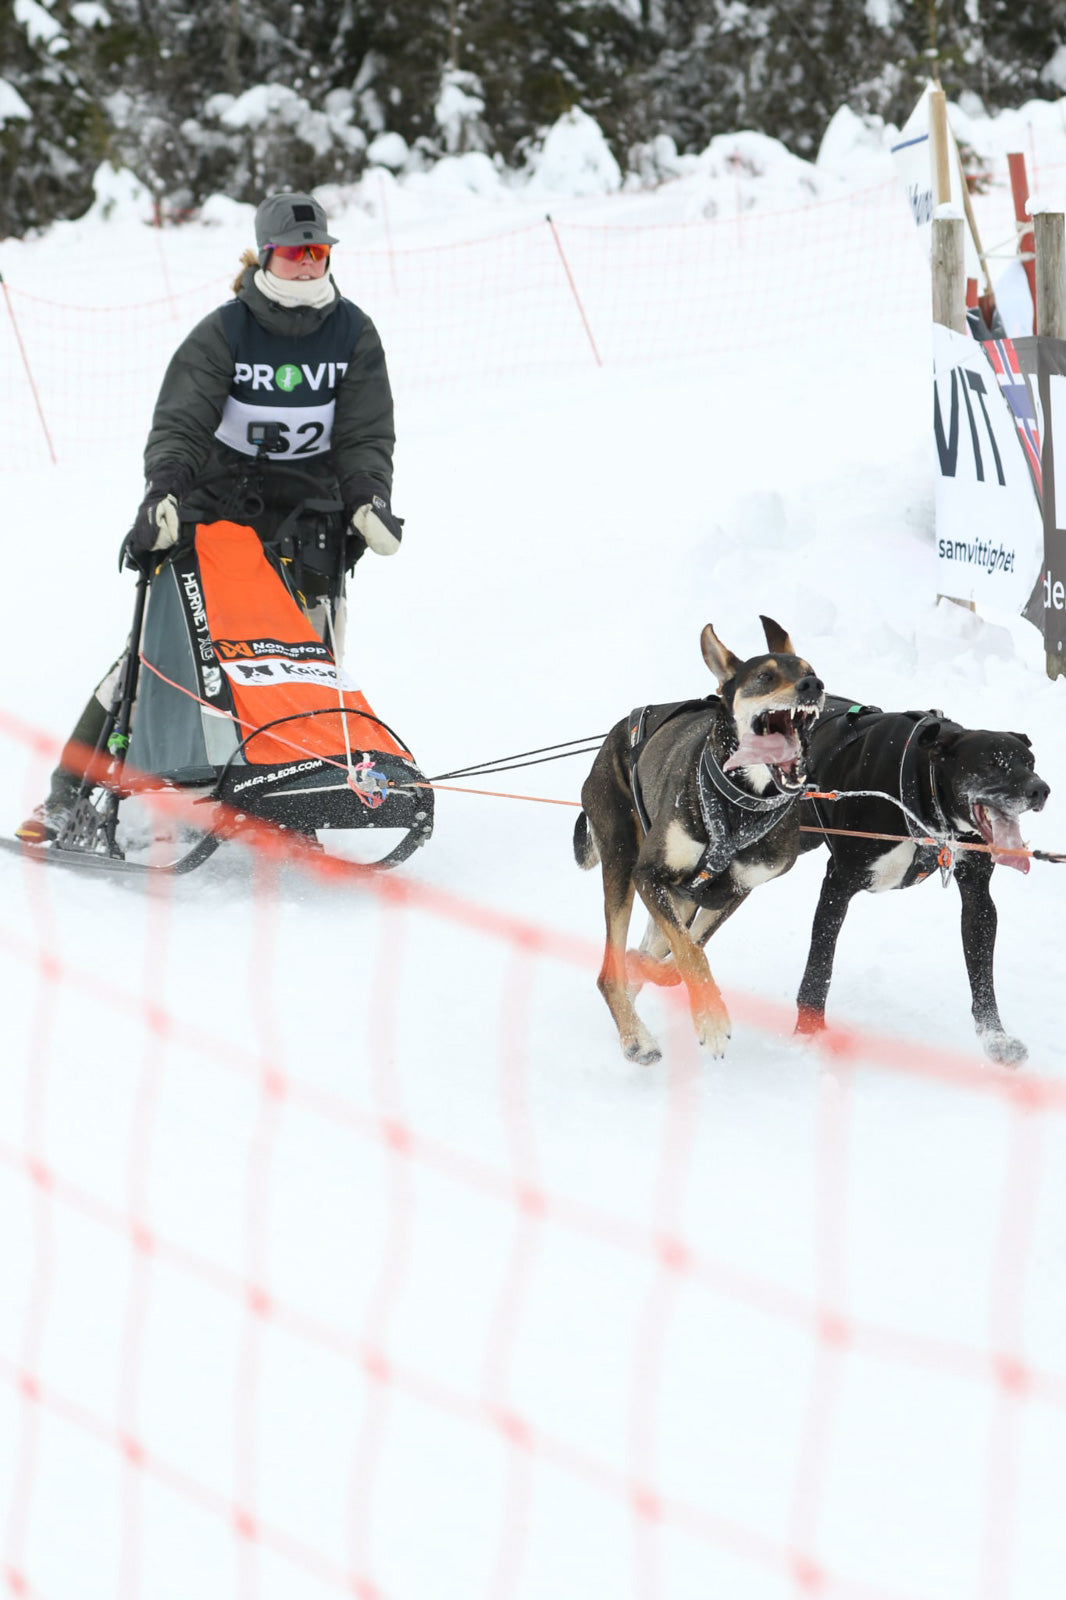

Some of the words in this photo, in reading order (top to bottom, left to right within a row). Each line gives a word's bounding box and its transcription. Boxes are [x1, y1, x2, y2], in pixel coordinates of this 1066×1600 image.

[938, 537, 1015, 574] samvittighet
[181, 572, 209, 633] HORNET
[1043, 570, 1066, 610] de
[252, 642, 327, 655] Non-stop
